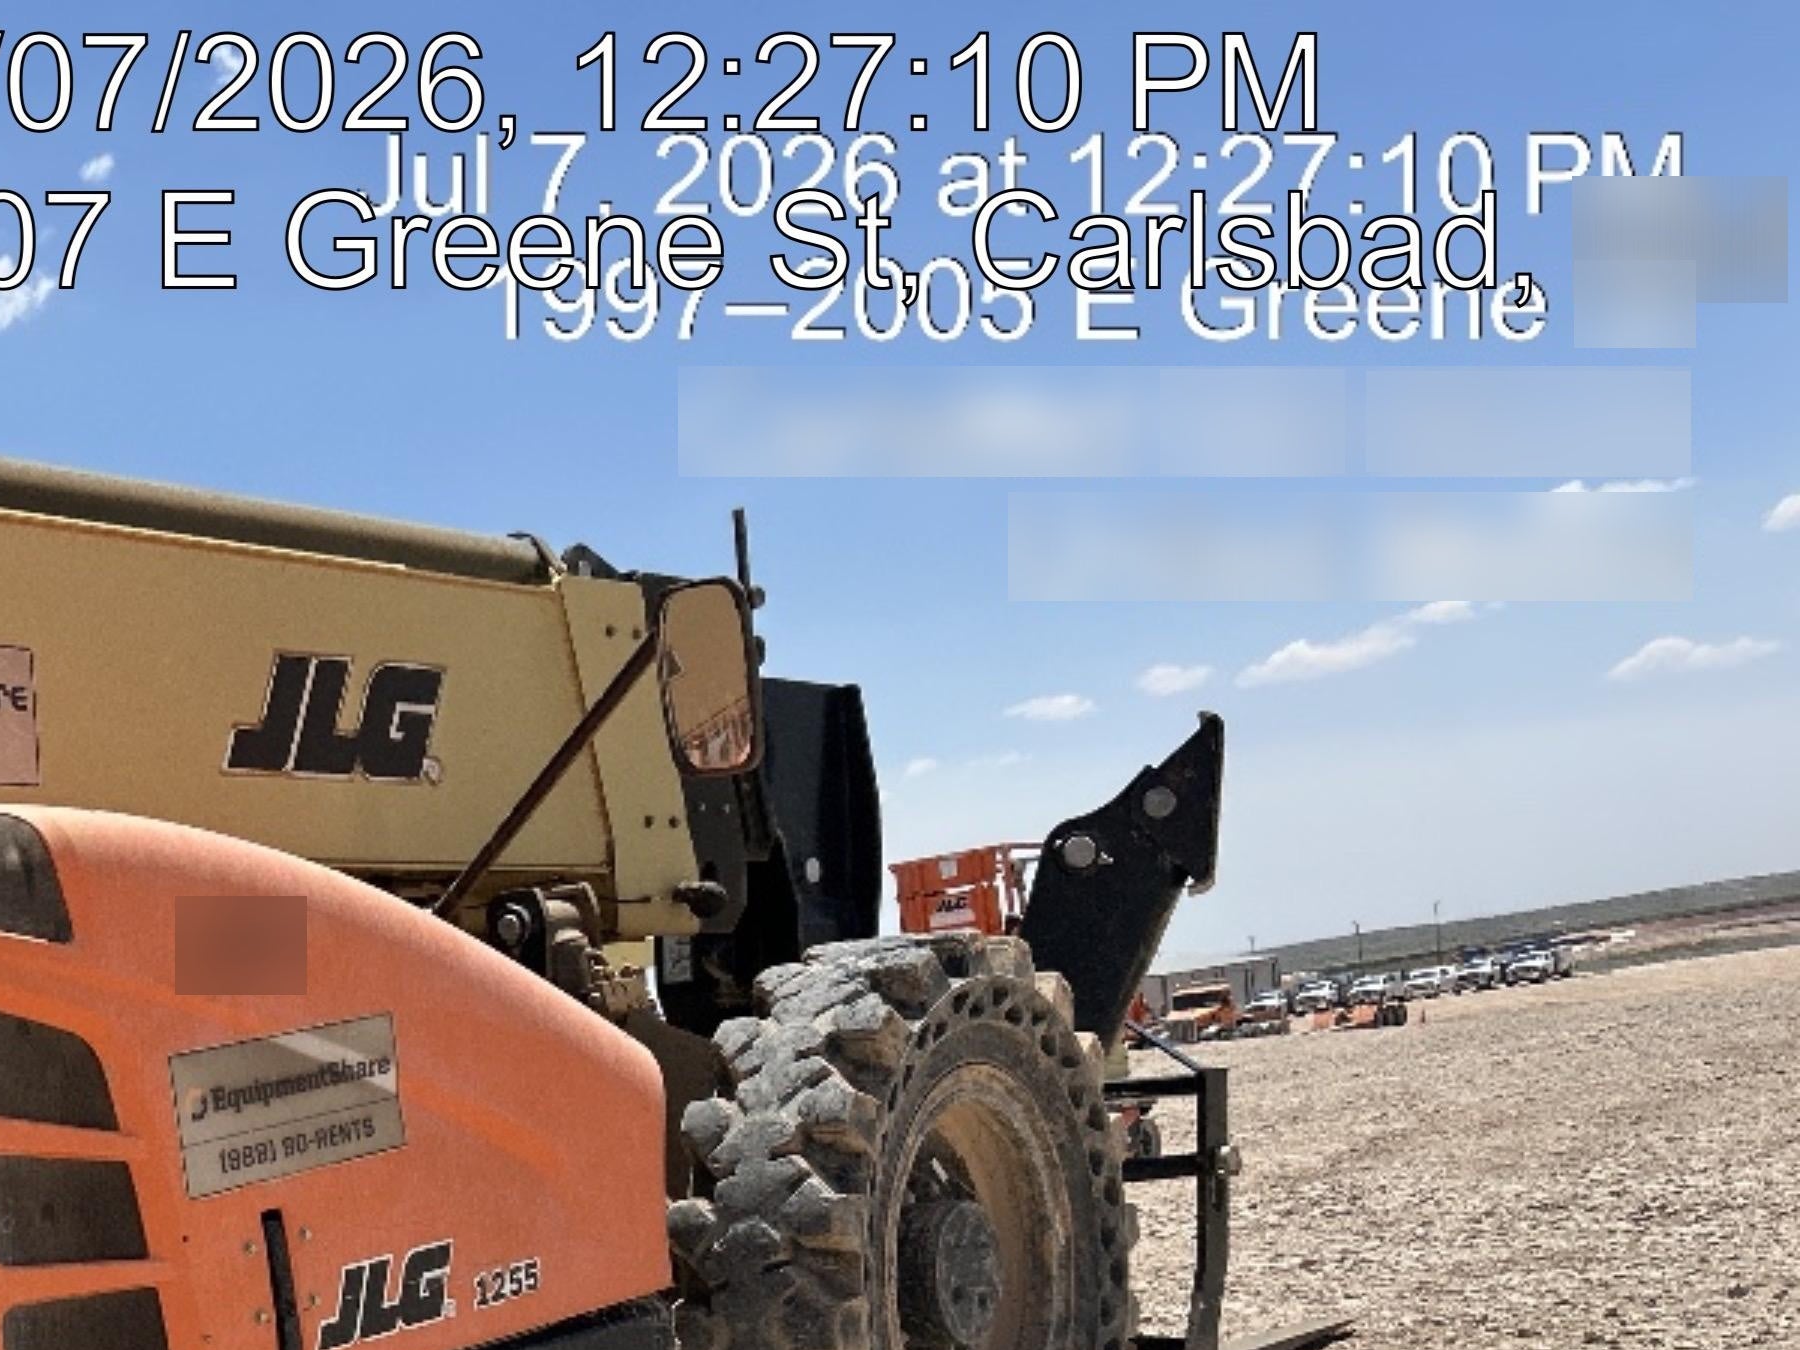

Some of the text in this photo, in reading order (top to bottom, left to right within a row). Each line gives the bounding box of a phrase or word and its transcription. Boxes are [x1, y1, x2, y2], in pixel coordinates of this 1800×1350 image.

[220, 650, 447, 784] JLG
[209, 1055, 392, 1114] EquipmentShare
[473, 1256, 541, 1311] 1255
